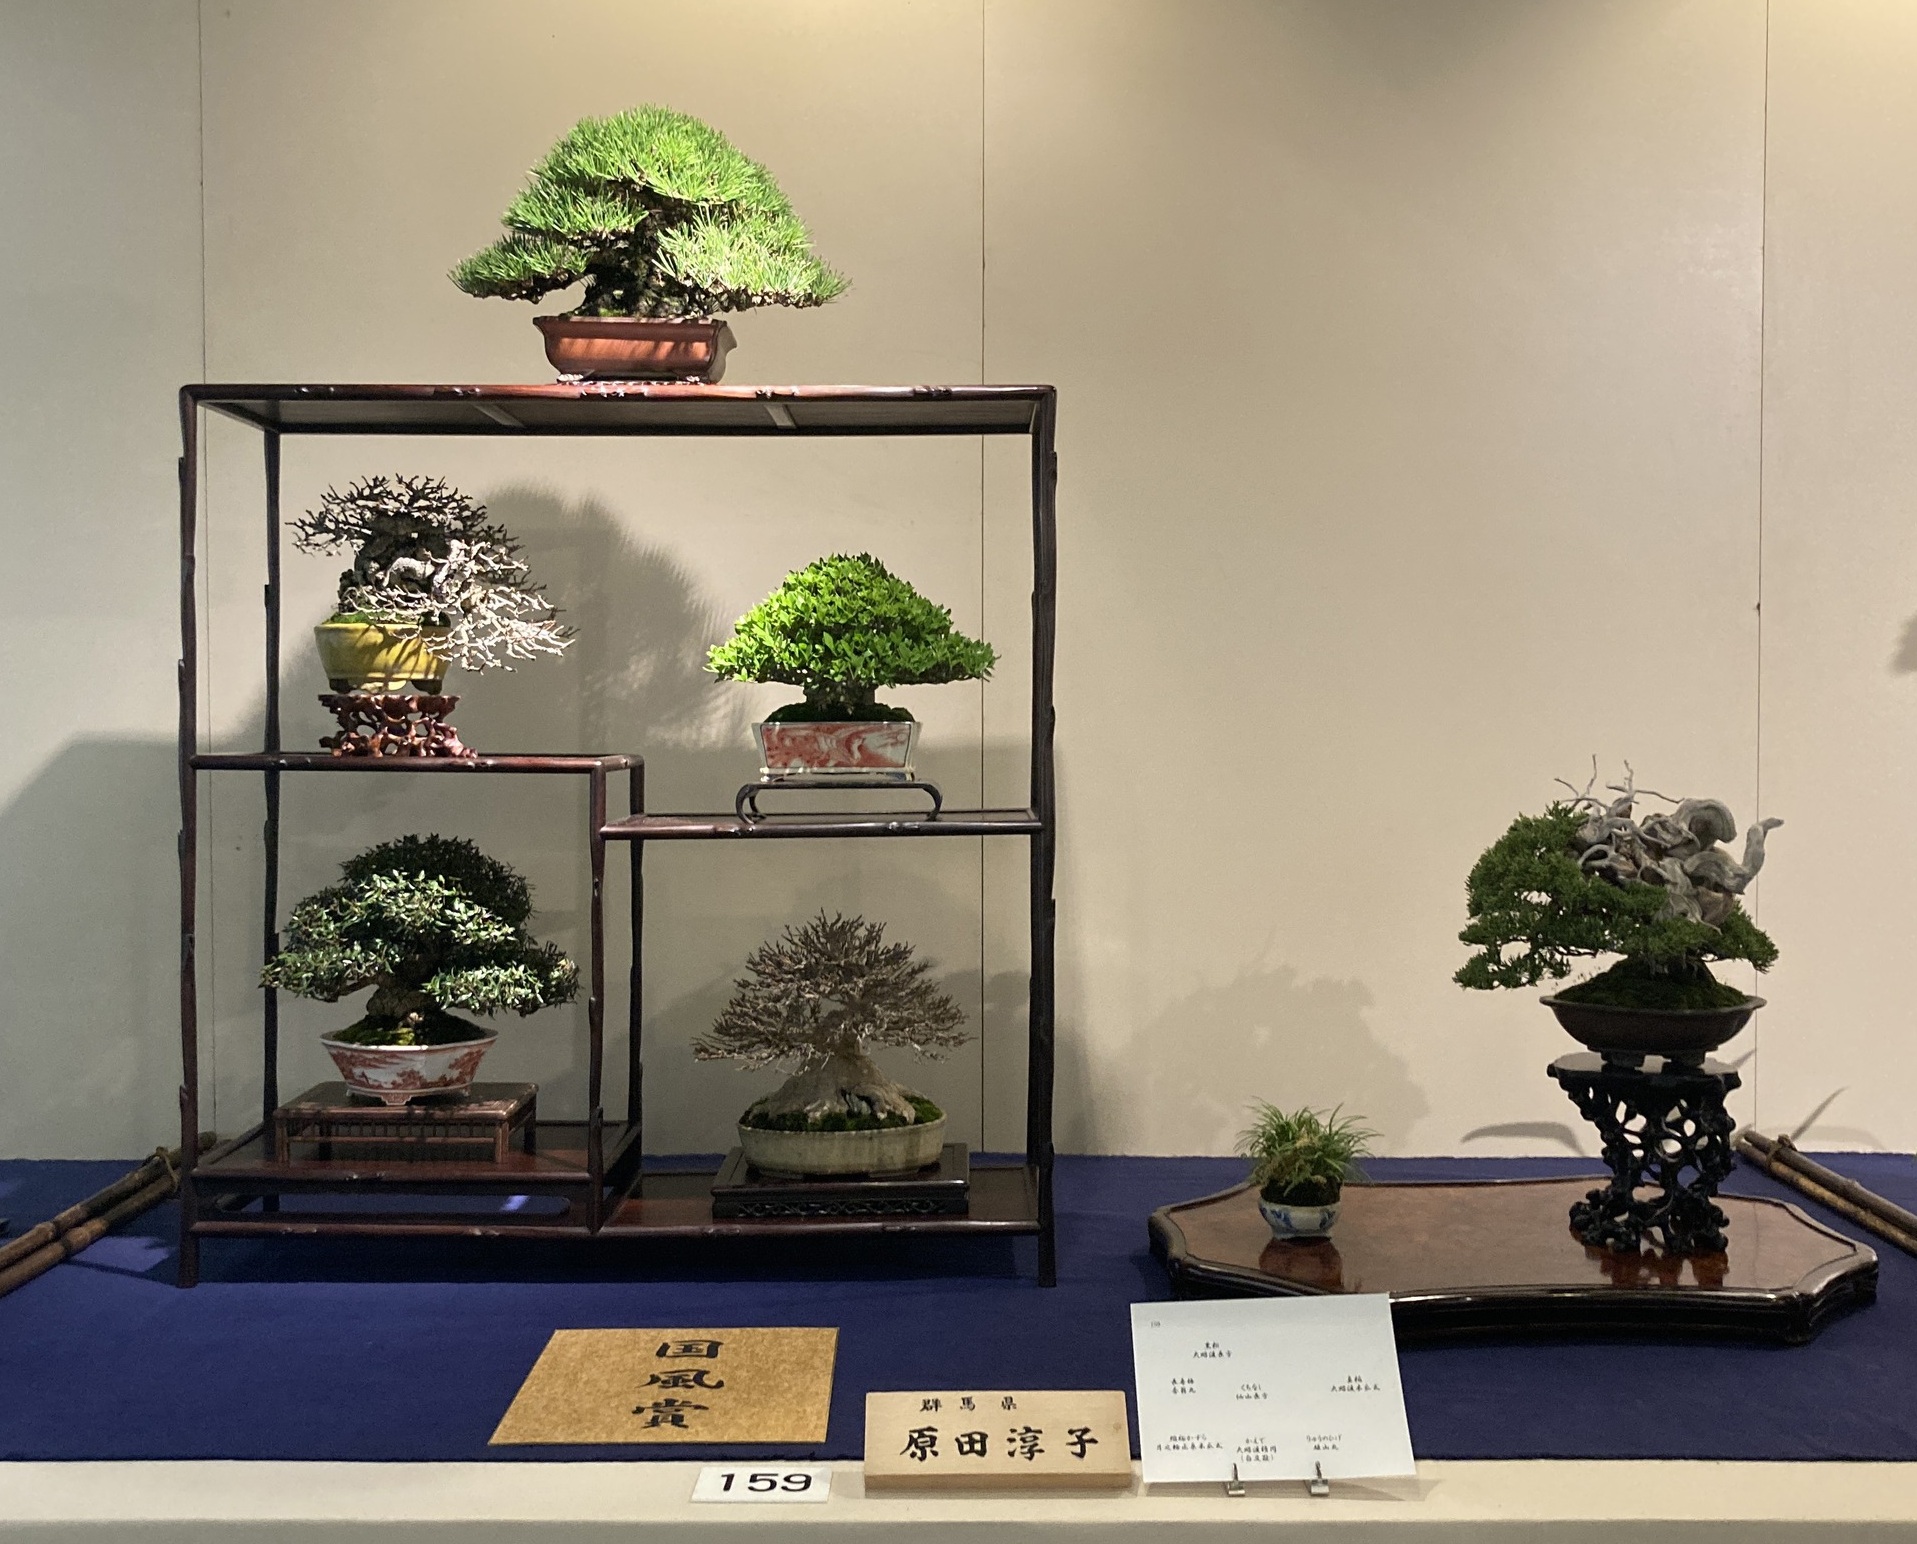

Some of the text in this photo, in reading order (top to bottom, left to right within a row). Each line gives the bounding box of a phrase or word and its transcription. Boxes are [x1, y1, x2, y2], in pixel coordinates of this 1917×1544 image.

[632, 1339, 725, 1429] 国風賞
[920, 1396, 1017, 1412] 群馬県
[899, 1425, 1099, 1462] 原田淳子
[721, 1472, 813, 1493] 159
